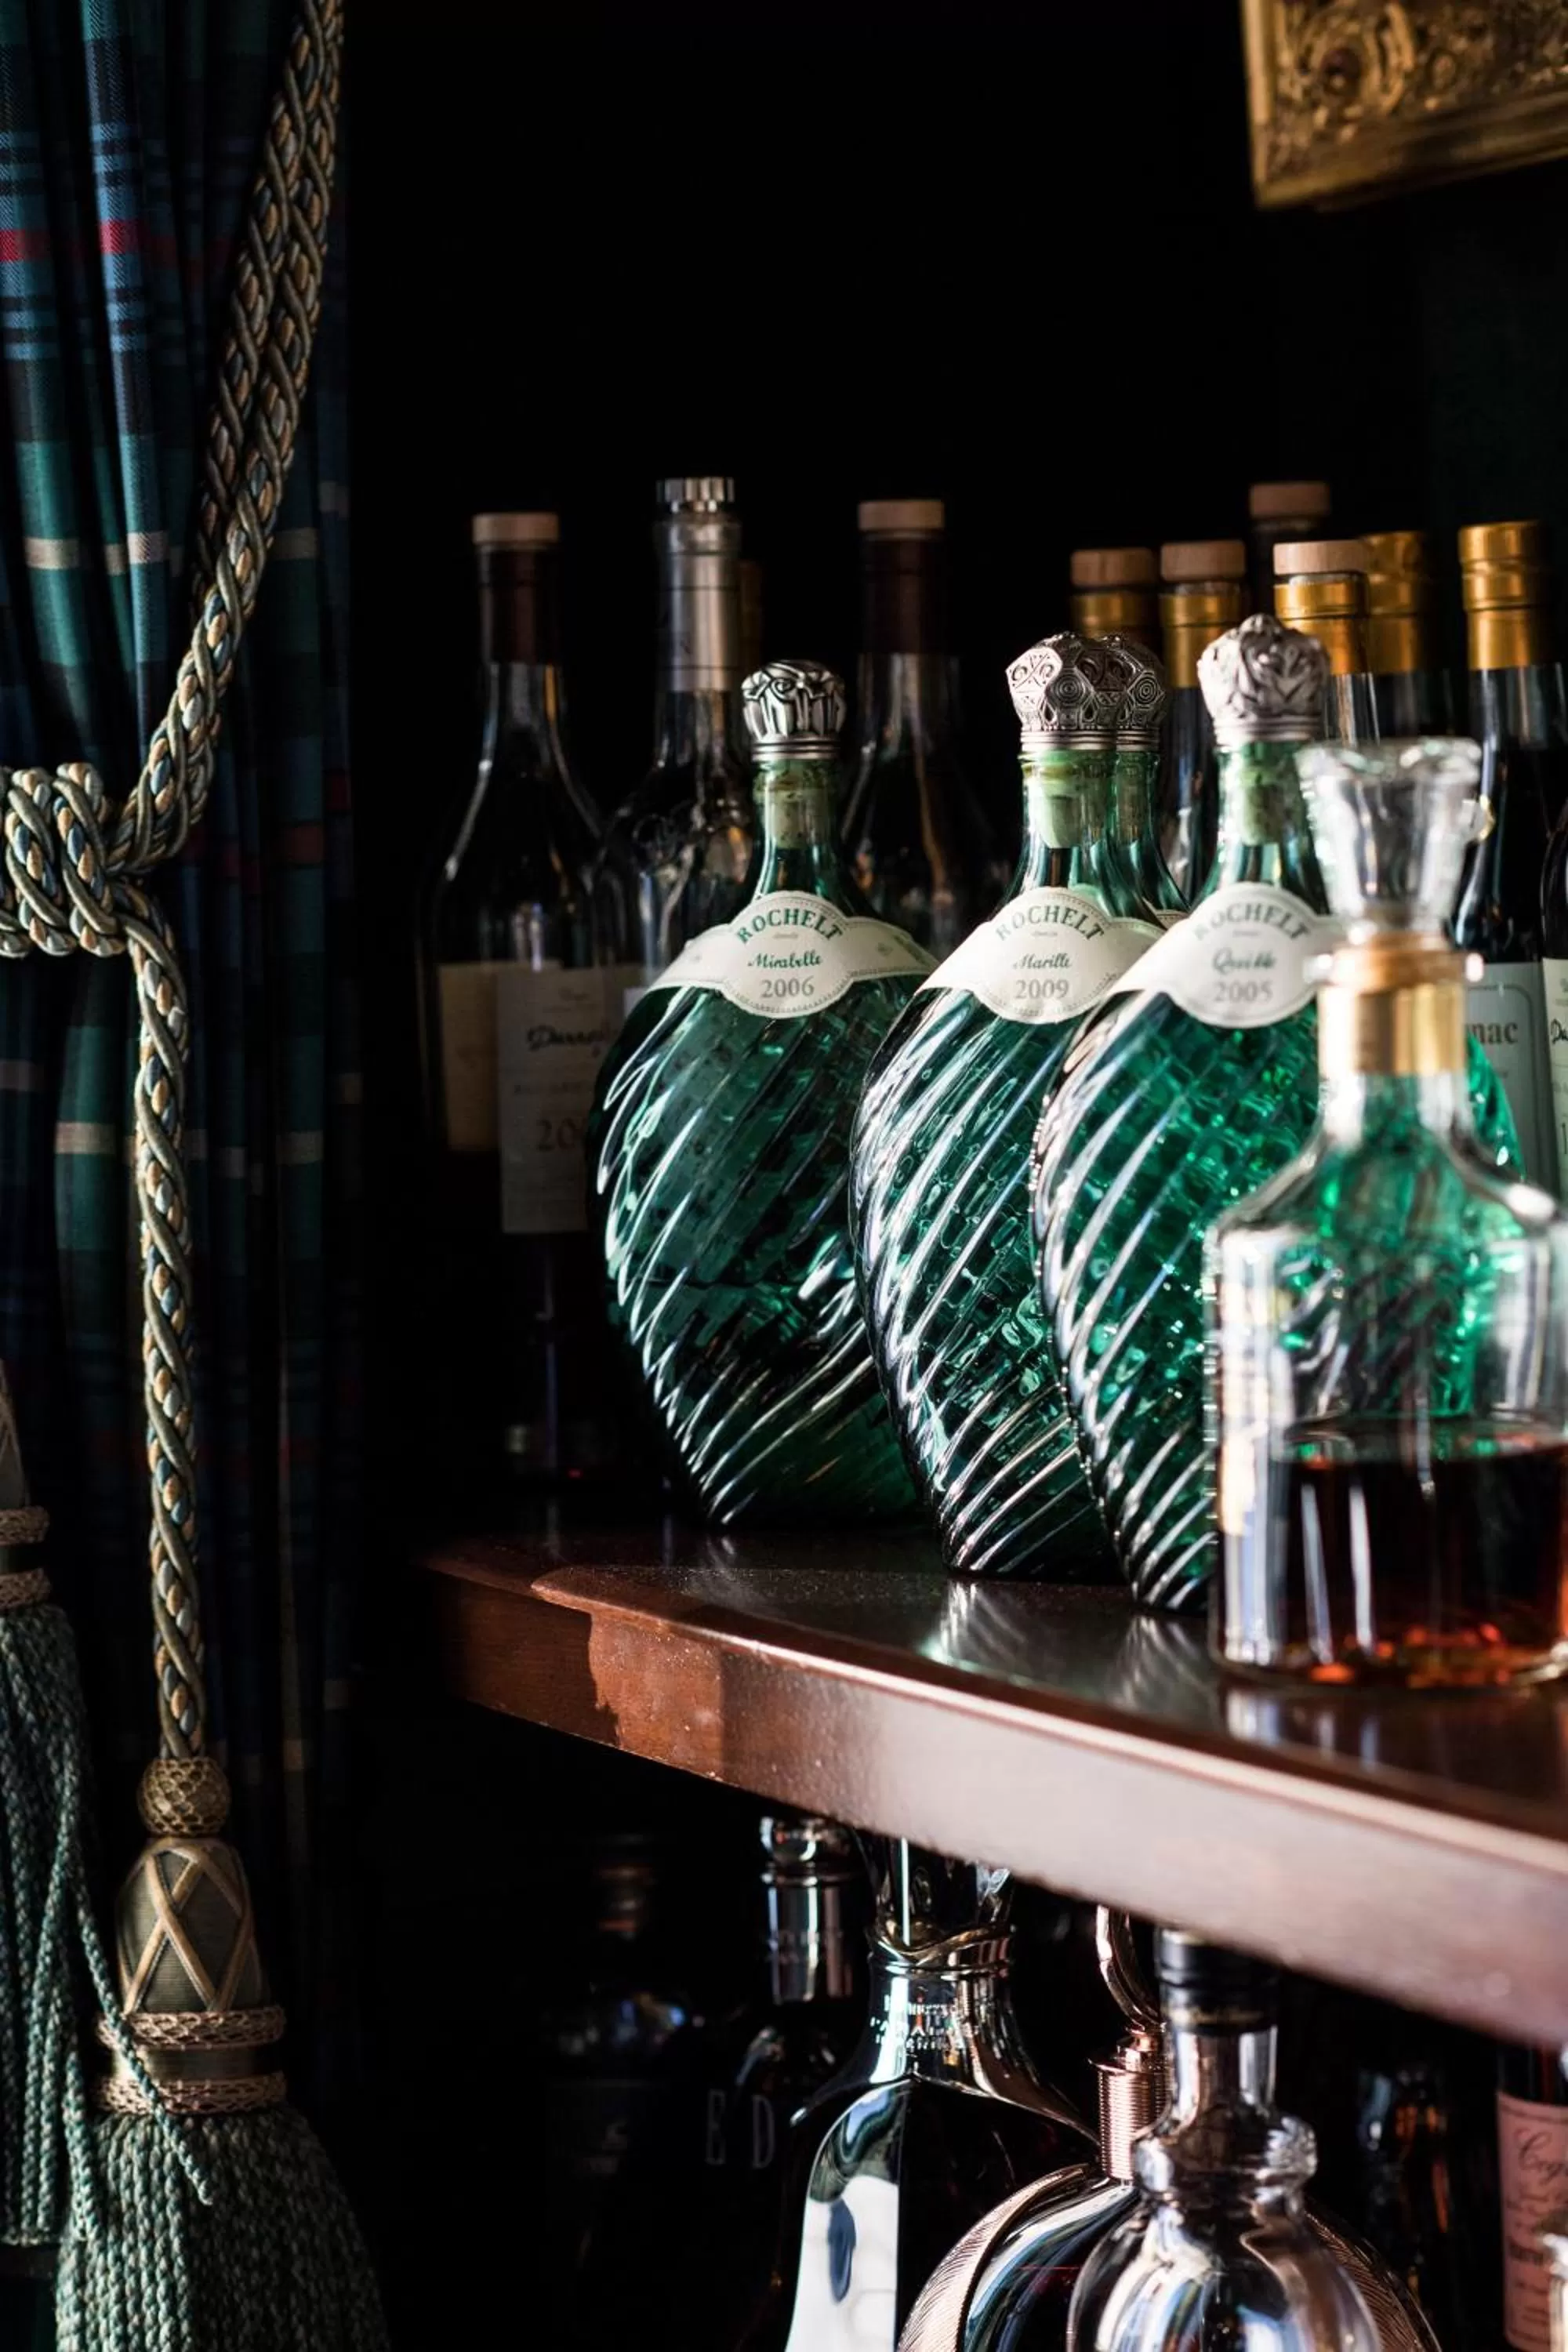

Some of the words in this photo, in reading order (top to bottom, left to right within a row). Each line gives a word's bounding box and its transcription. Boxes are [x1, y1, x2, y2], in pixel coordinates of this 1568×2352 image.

[736, 907, 844, 944] ROCHELT
[996, 906, 1105, 941] ROCHELT
[1192, 902, 1309, 941] ROCHELT
[747, 949, 822, 970] Mirabelle
[760, 977, 815, 998] 2006
[1014, 978, 1069, 1000] 2009
[1213, 979, 1273, 1003] 2005
[1466, 1022, 1519, 1045] nac
[536, 1118, 586, 1151] 20
